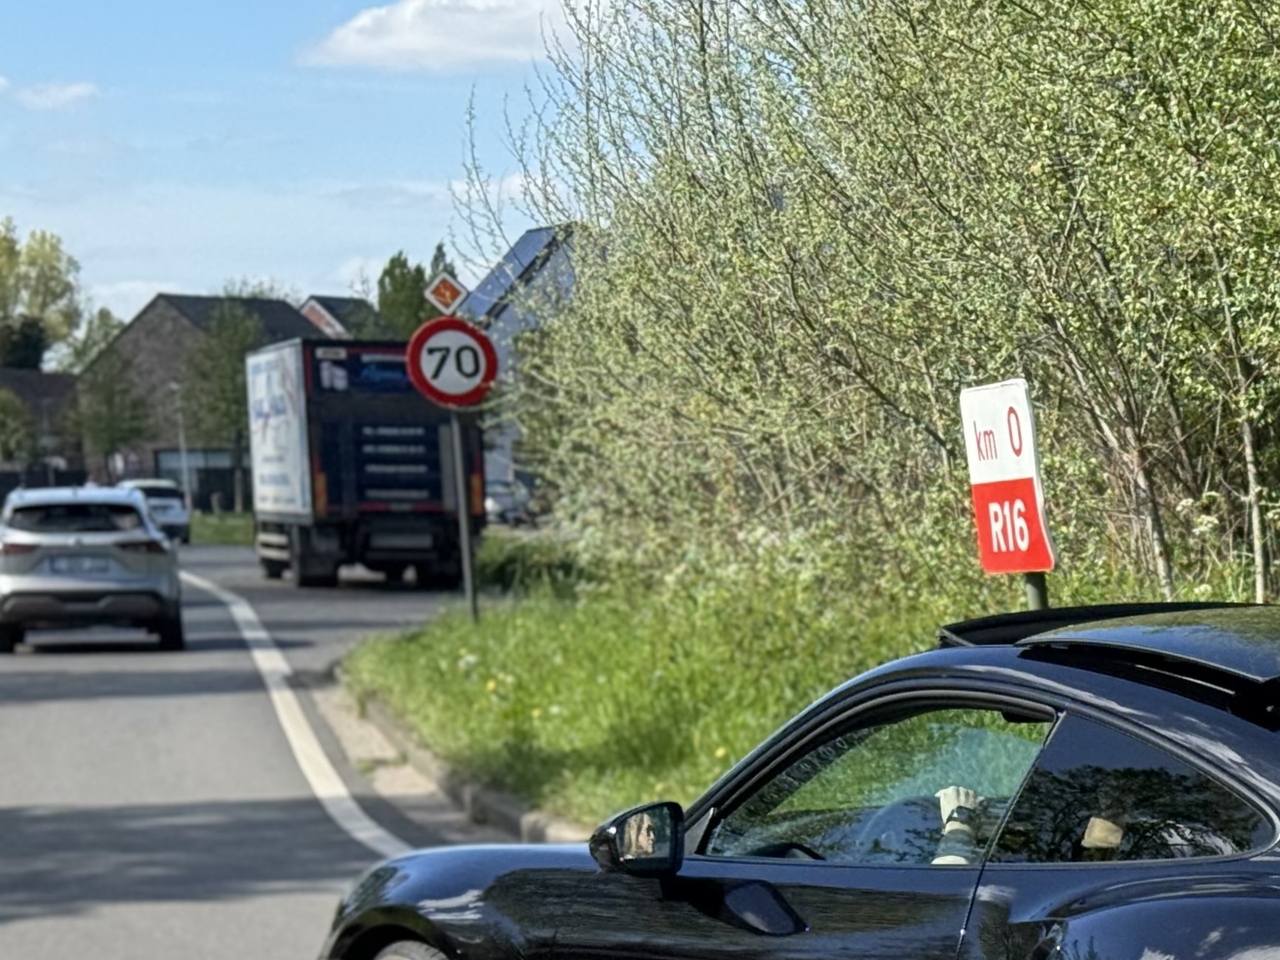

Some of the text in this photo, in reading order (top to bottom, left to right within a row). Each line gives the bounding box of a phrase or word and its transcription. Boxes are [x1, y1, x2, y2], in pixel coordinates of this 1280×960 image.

[427, 345, 480, 380] 70
[973, 406, 1023, 461] km 0
[988, 498, 1029, 553] R16
